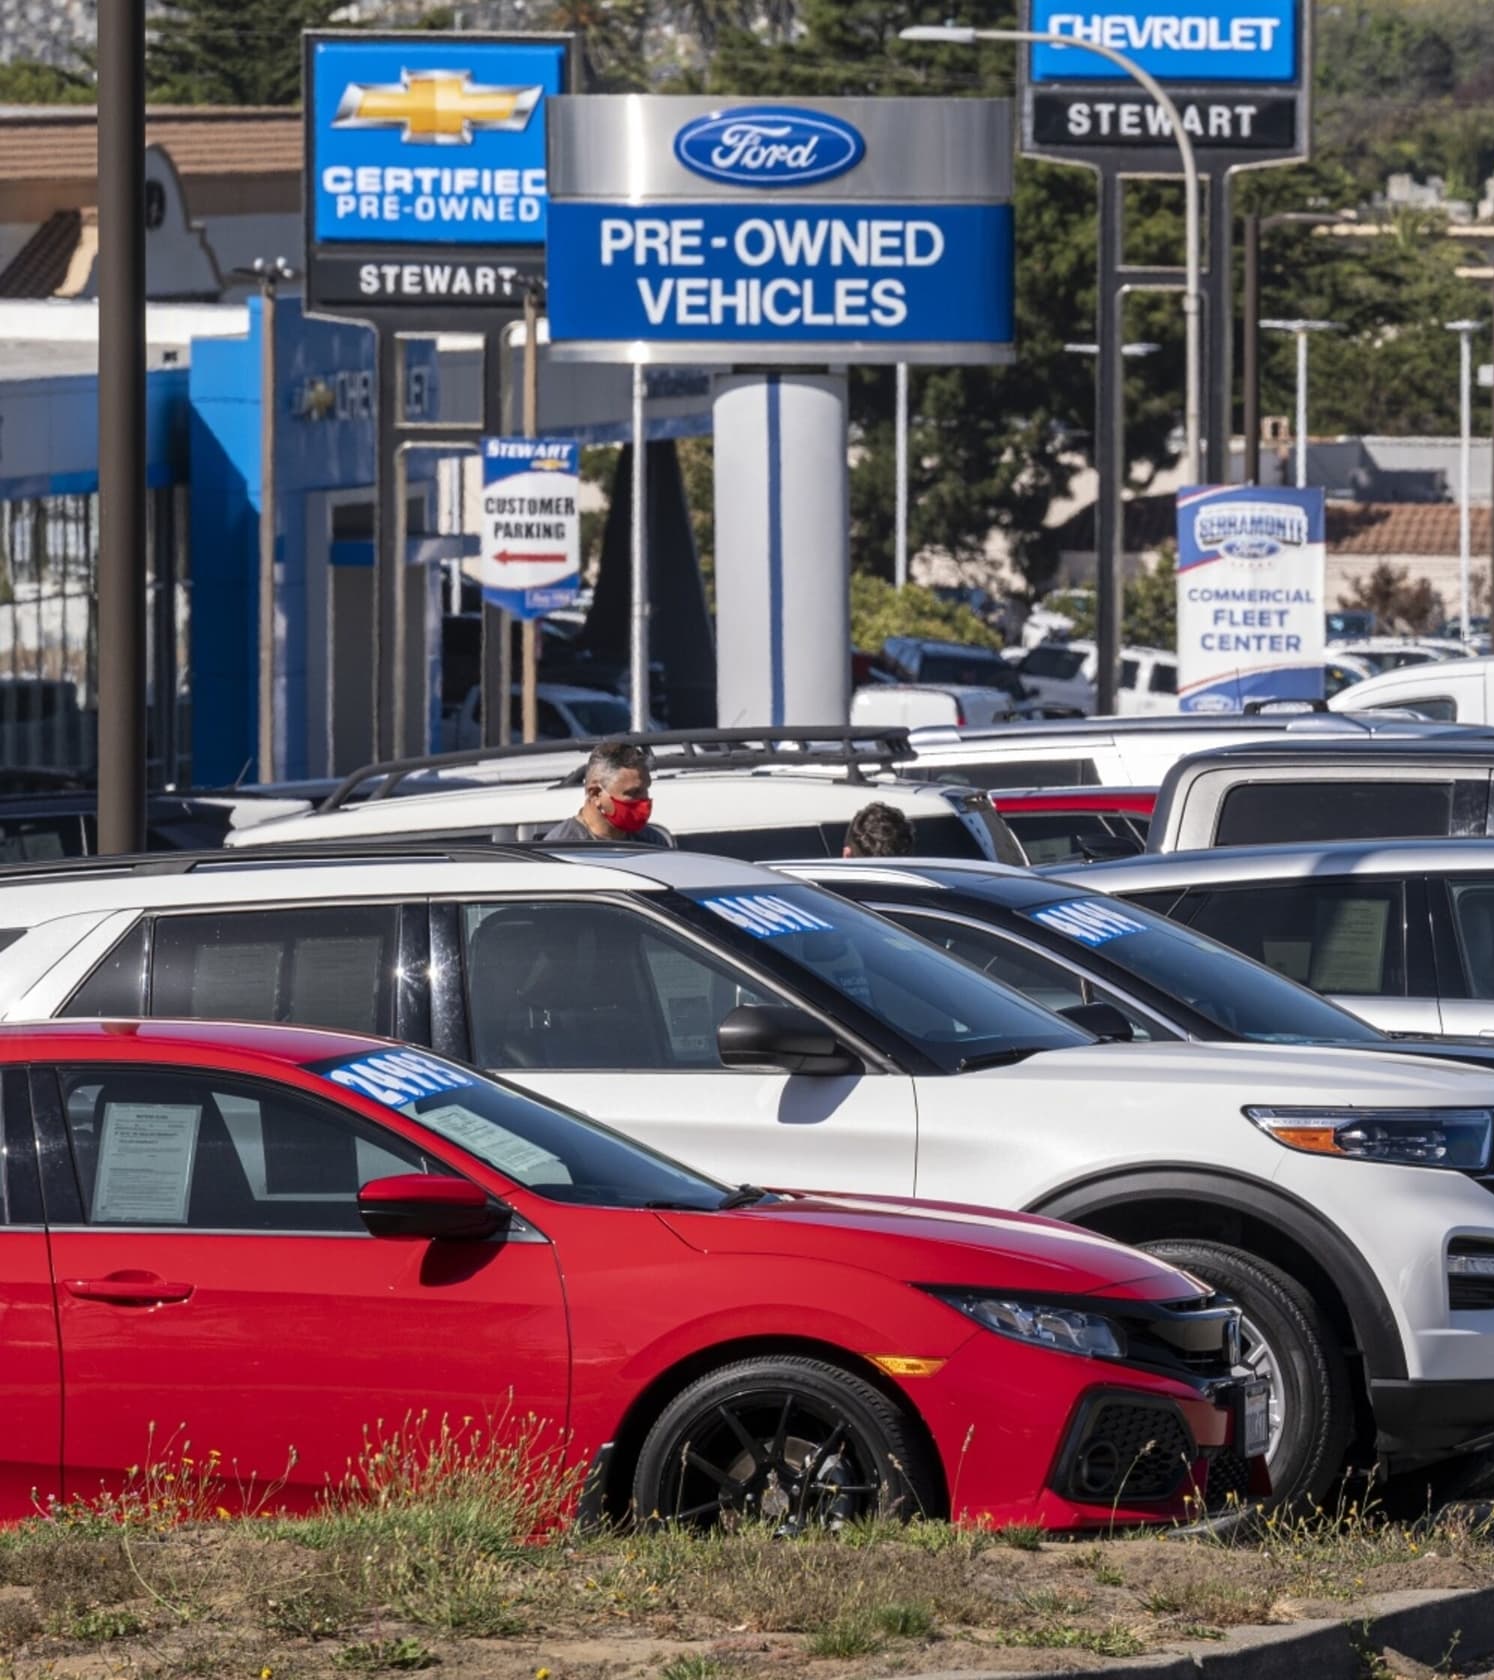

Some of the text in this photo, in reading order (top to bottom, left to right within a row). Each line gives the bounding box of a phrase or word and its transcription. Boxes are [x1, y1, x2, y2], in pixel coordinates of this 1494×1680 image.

[1049, 14, 1281, 51] CHEVROLET
[1067, 103, 1258, 138] STEWART
[711, 123, 820, 169] Ford
[336, 195, 541, 222] PRE-OWNED
[359, 264, 517, 296] STEWART
[636, 277, 909, 327] VEHICLES
[486, 439, 573, 460] STEWART
[484, 497, 576, 516] CUSTOMER
[493, 522, 566, 540] PARKING
[1188, 588, 1315, 604] COMMERCIAL
[1213, 608, 1290, 628] FLEET
[1200, 633, 1303, 652] CENTER
